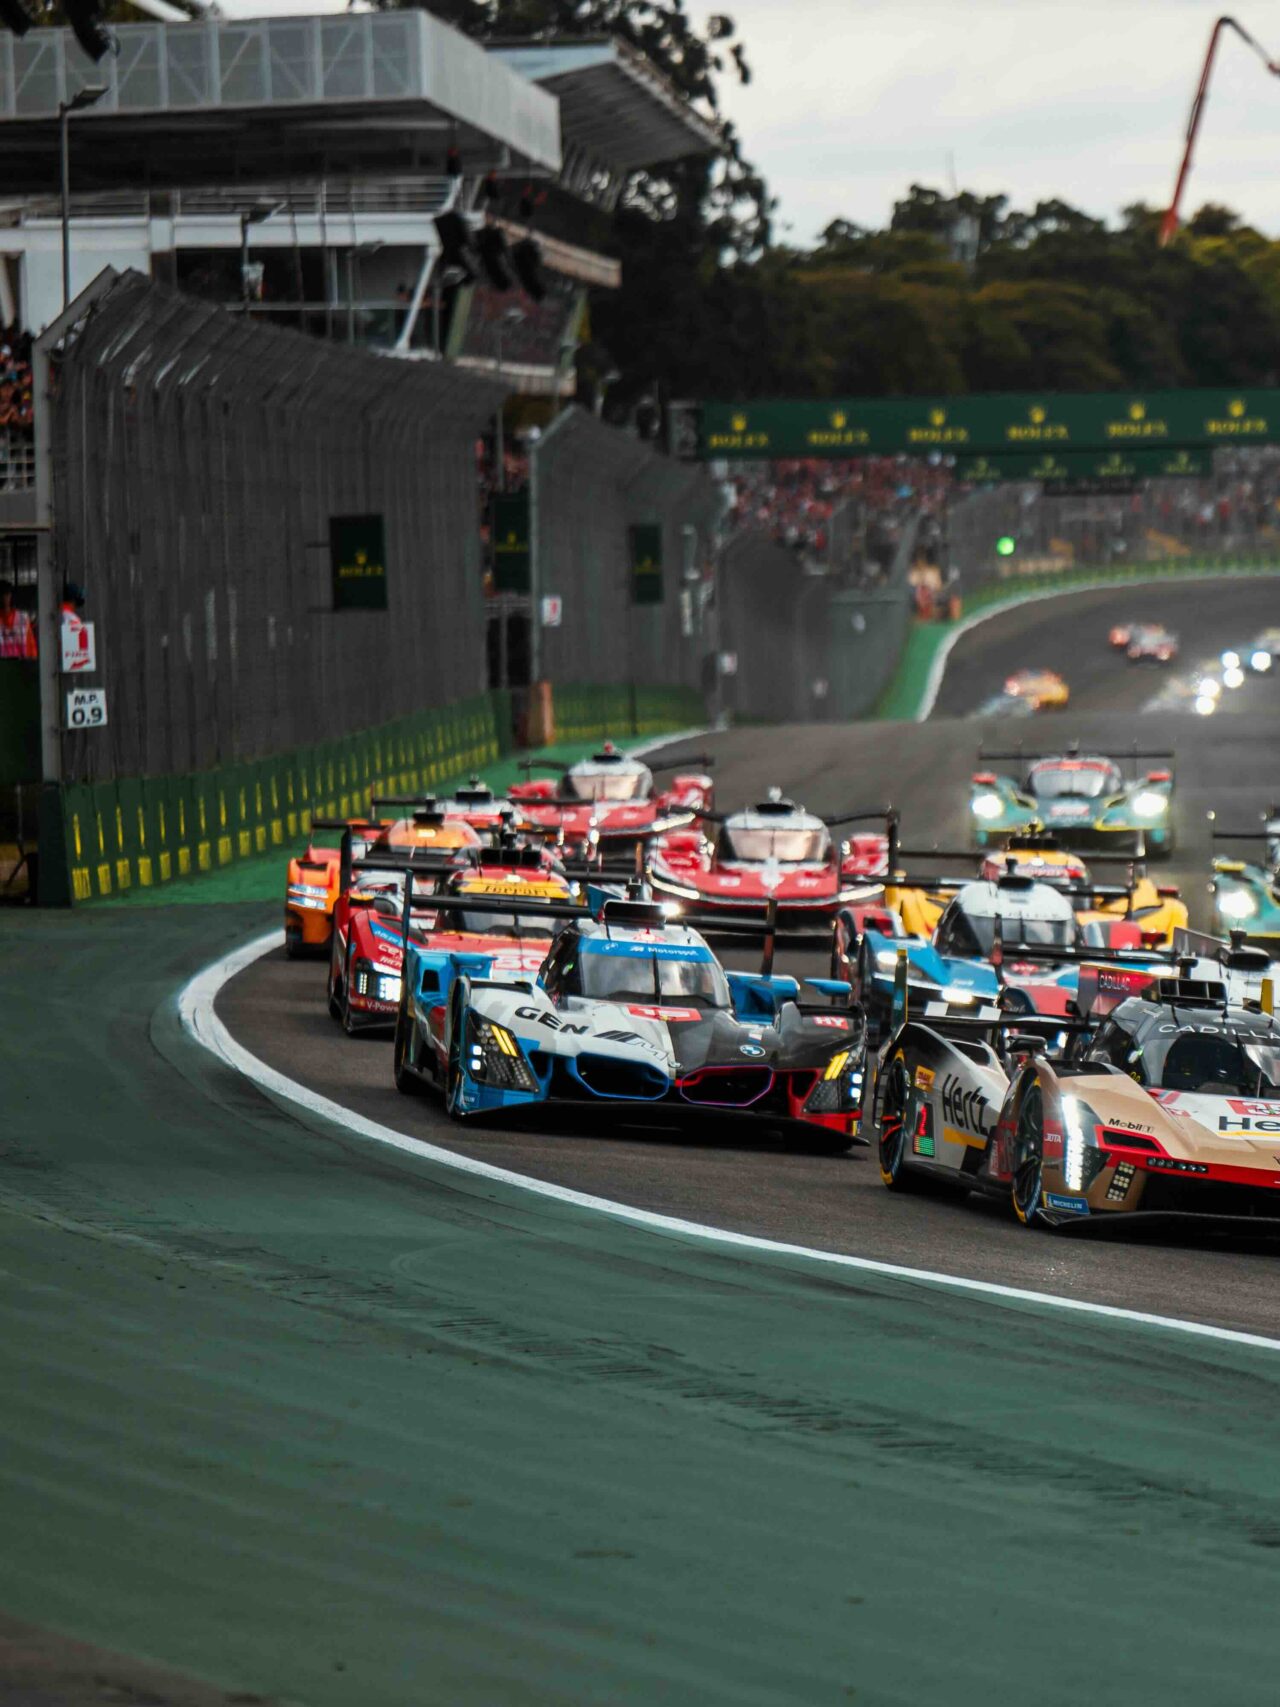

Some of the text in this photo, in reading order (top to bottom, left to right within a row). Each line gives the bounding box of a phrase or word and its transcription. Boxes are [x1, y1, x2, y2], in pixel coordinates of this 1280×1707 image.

[514, 1006, 590, 1035] GEN
[814, 1015, 848, 1028] HY
[942, 1073, 990, 1136] Hertz
[1044, 1133, 1062, 1143] JOTA
